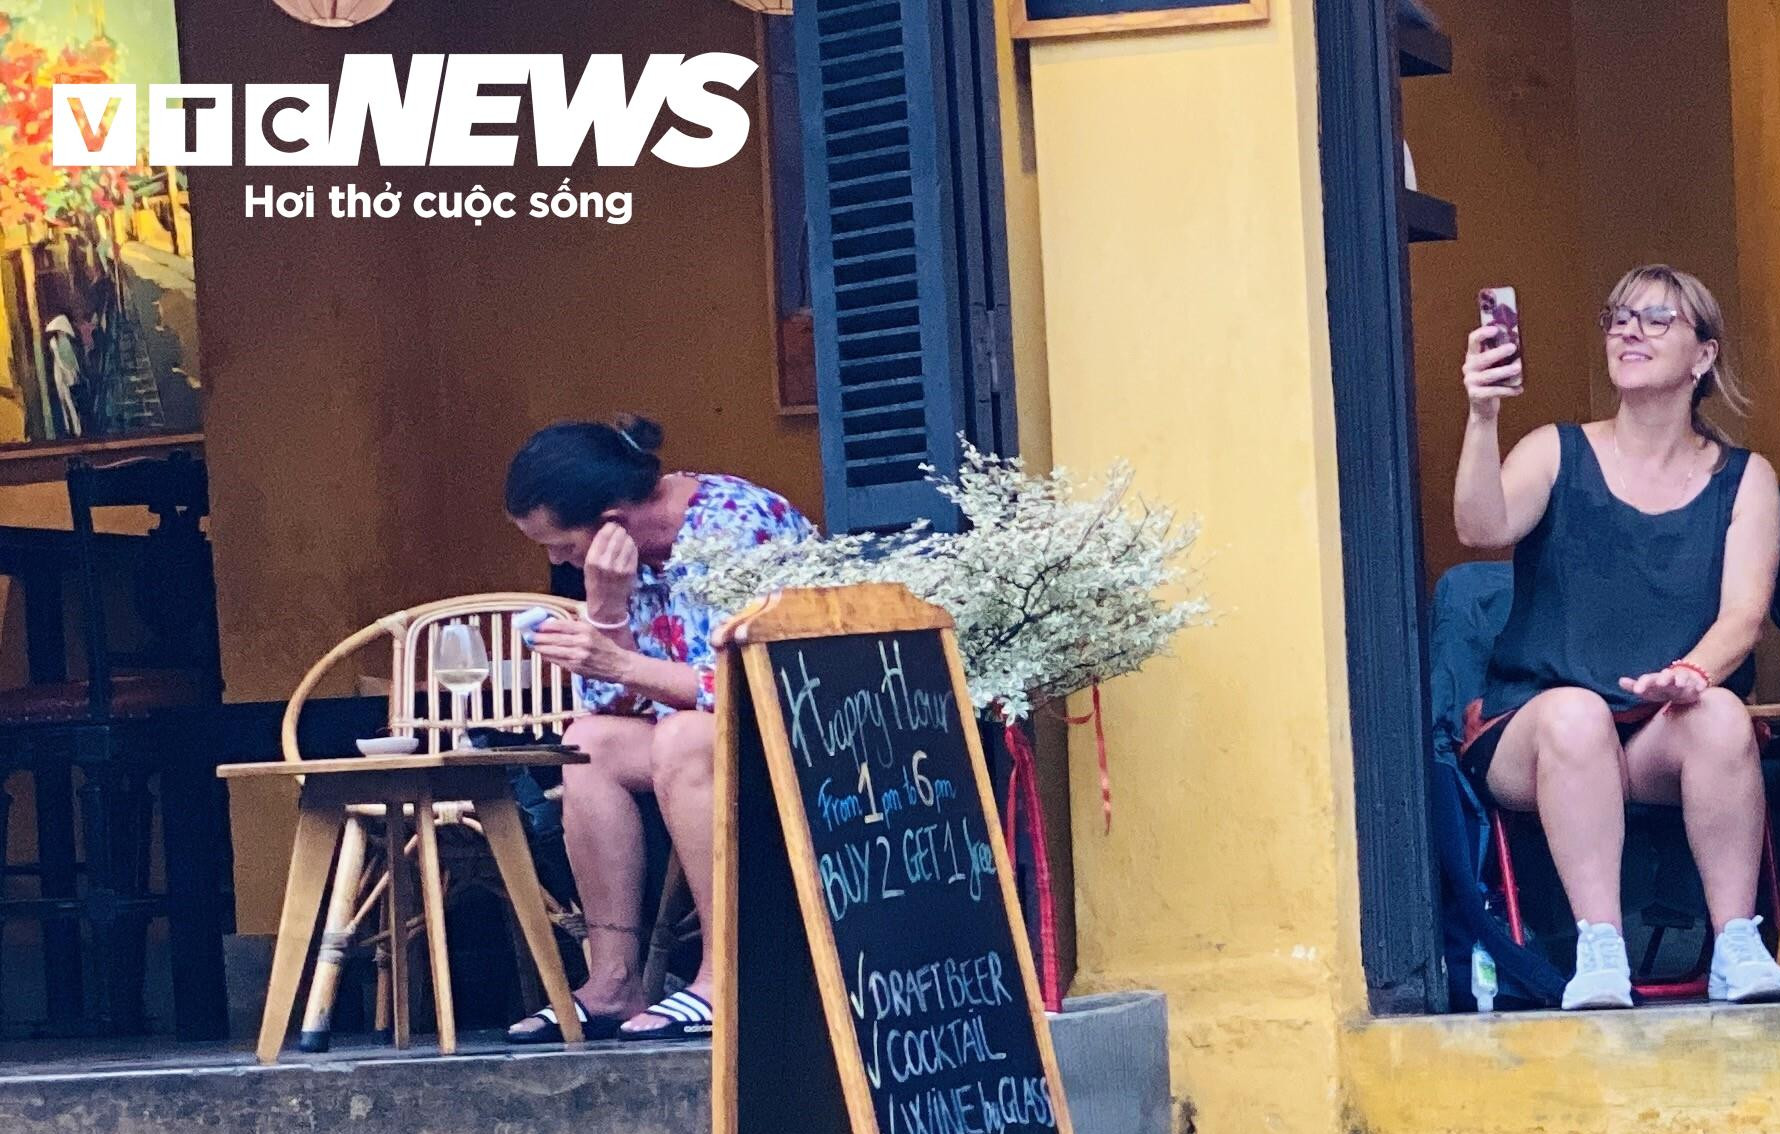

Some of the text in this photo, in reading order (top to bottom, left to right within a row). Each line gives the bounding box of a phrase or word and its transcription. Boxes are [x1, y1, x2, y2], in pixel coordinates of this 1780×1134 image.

[781, 639, 954, 774] Happy Hour
[818, 777, 863, 832] From
[903, 765, 917, 805] to
[820, 840, 870, 921] BUY
[876, 836, 905, 899] 2
[903, 824, 938, 883] GET
[944, 820, 967, 884] 1
[869, 951, 1012, 1020] DRAFT BEER
[998, 1076, 1055, 1128] GLASS
